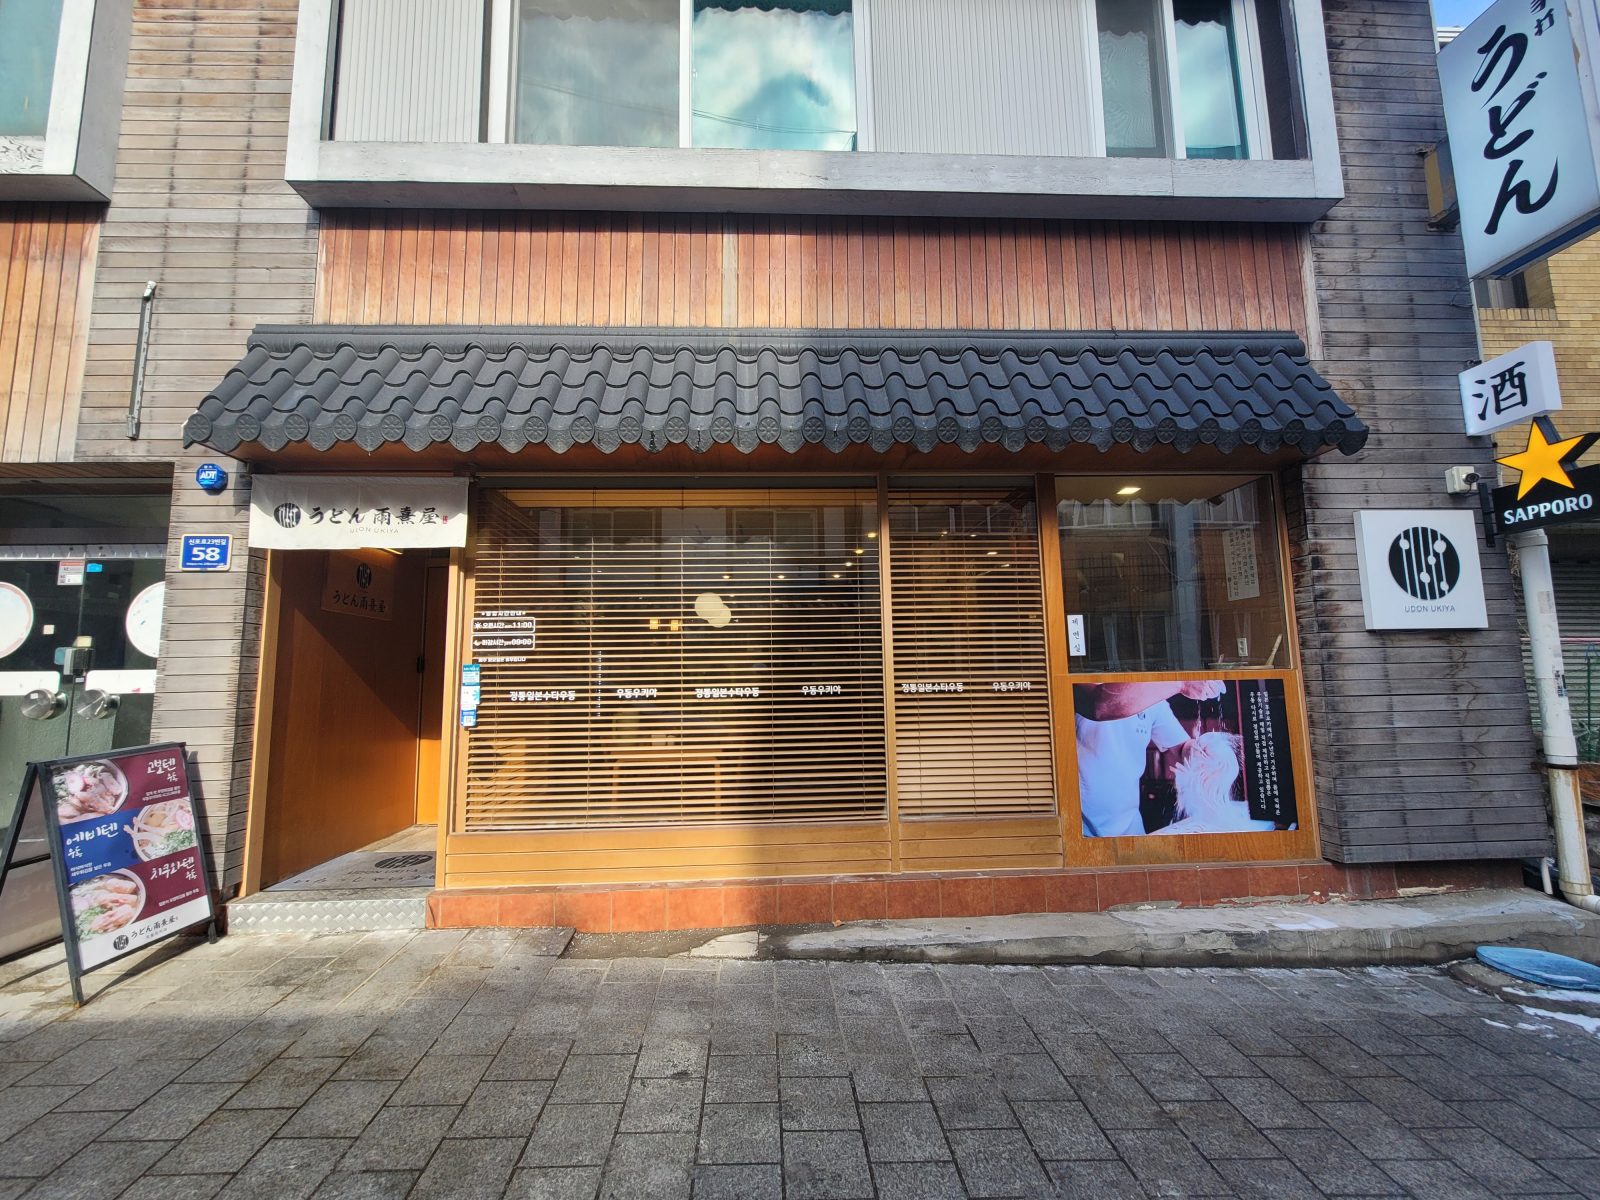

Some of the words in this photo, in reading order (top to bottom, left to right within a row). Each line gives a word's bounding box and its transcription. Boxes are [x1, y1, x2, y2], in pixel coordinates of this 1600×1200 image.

[1471, 25, 1558, 235] うどん
[1472, 361, 1528, 421] 酒
[200, 470, 216, 479] ADT
[1504, 493, 1593, 525] SAPPORO
[191, 547, 220, 561] 58
[1404, 604, 1428, 613] UDON
[1431, 604, 1456, 613] UKIYA
[512, 621, 532, 629] 11:00
[509, 690, 576, 701] 정통일본수타우동
[616, 688, 657, 699] 우동우키야
[695, 687, 760, 698] 정통일본수타우동
[801, 685, 841, 696] 우동우키야
[901, 682, 964, 693] 정통일본수타우동
[992, 681, 1031, 691] 우동우키야
[66, 822, 119, 845] 에비텐
[67, 846, 83, 859] 우동
[150, 856, 195, 880] 치쿠와텐
